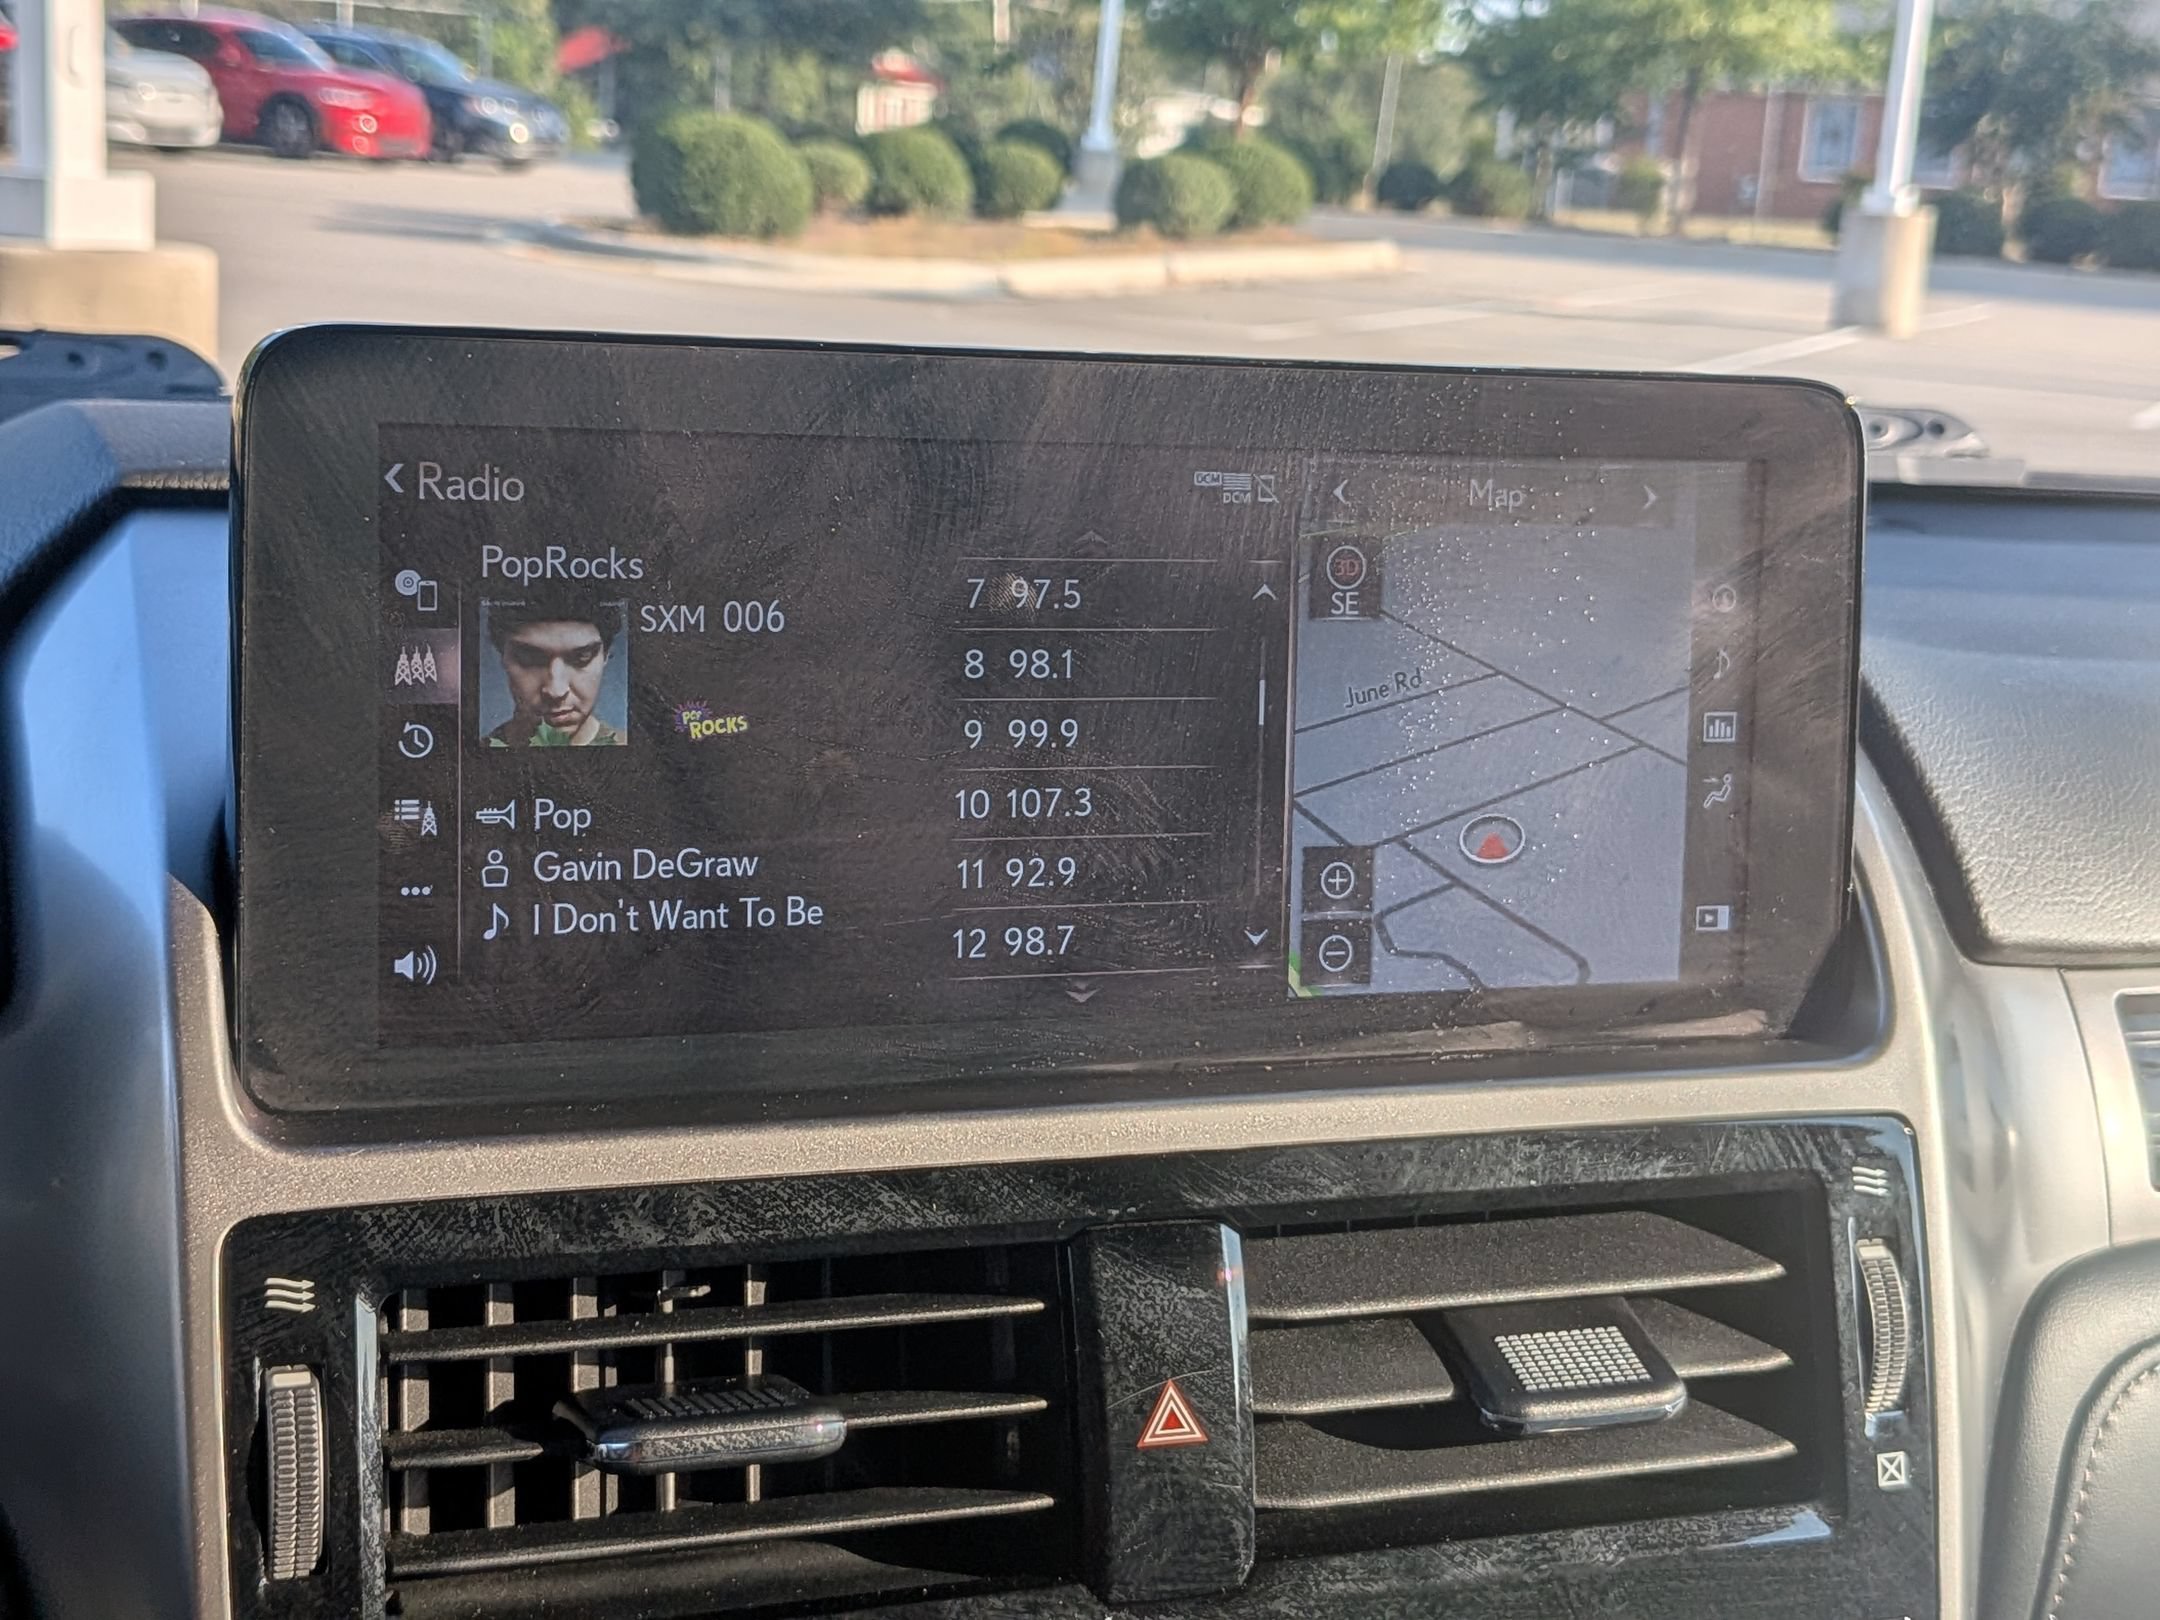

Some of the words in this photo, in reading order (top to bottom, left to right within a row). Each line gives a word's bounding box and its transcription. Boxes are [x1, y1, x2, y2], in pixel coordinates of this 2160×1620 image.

[418, 461, 525, 502] Radio
[1223, 491, 1251, 504] DCM
[1469, 479, 1525, 512] Map
[482, 545, 644, 586] PopRocks
[1334, 558, 1361, 576] 3D
[967, 578, 985, 609] 7
[1011, 578, 1081, 609] 97.5
[1331, 591, 1360, 616] SE
[640, 604, 706, 633] SXM
[723, 600, 785, 633] 006
[964, 649, 984, 679] 8
[1009, 649, 1073, 679] 98.1
[1345, 684, 1390, 709] June
[1394, 667, 1423, 693] Rd
[690, 715, 748, 739] ROCKS
[964, 719, 983, 749] 9
[1008, 718, 1079, 748] 99.9
[534, 798, 592, 834] Pop
[955, 788, 990, 819] 10
[1007, 787, 1092, 818] 107.3
[533, 850, 622, 883] Gavin
[633, 847, 758, 880] DeGraw
[957, 858, 984, 889] 11
[1005, 856, 1077, 887] 92.9
[533, 903, 540, 935] I
[553, 899, 639, 934] Don't
[649, 899, 729, 931] Want
[739, 897, 776, 928] To
[786, 896, 824, 926] Be
[953, 928, 986, 959] 12
[1004, 925, 1075, 956] 98.7
